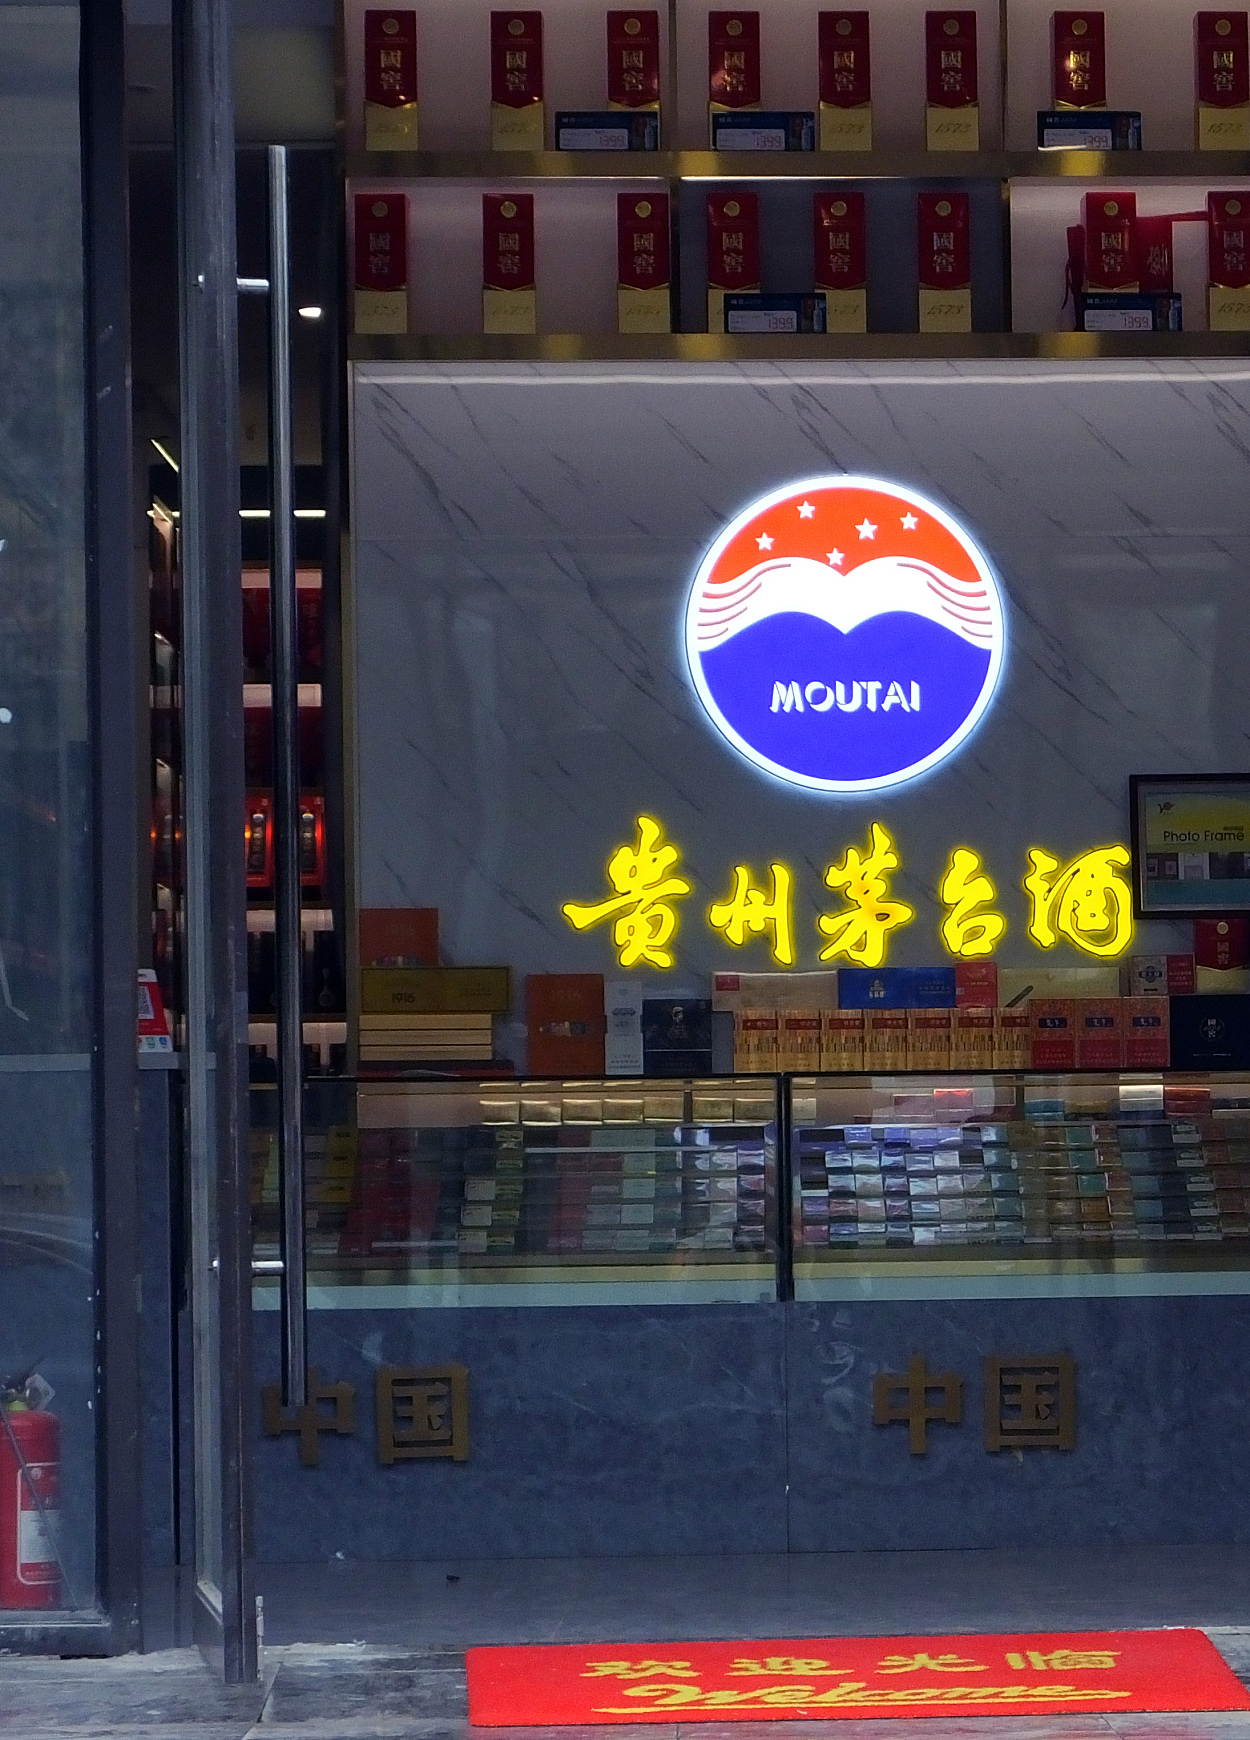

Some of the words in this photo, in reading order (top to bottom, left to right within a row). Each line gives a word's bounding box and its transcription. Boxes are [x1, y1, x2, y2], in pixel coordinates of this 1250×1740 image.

[769, 680, 921, 713] MOUTAI
[1163, 830, 1199, 842] Photo
[1204, 830, 1244, 842] Frame
[562, 816, 1133, 969] 贵州茅台酒
[263, 1362, 468, 1467] 中国
[873, 1353, 1076, 1454] 中国
[579, 1650, 1121, 1679] 欢迎光临
[592, 1682, 1132, 1713] Welcome
